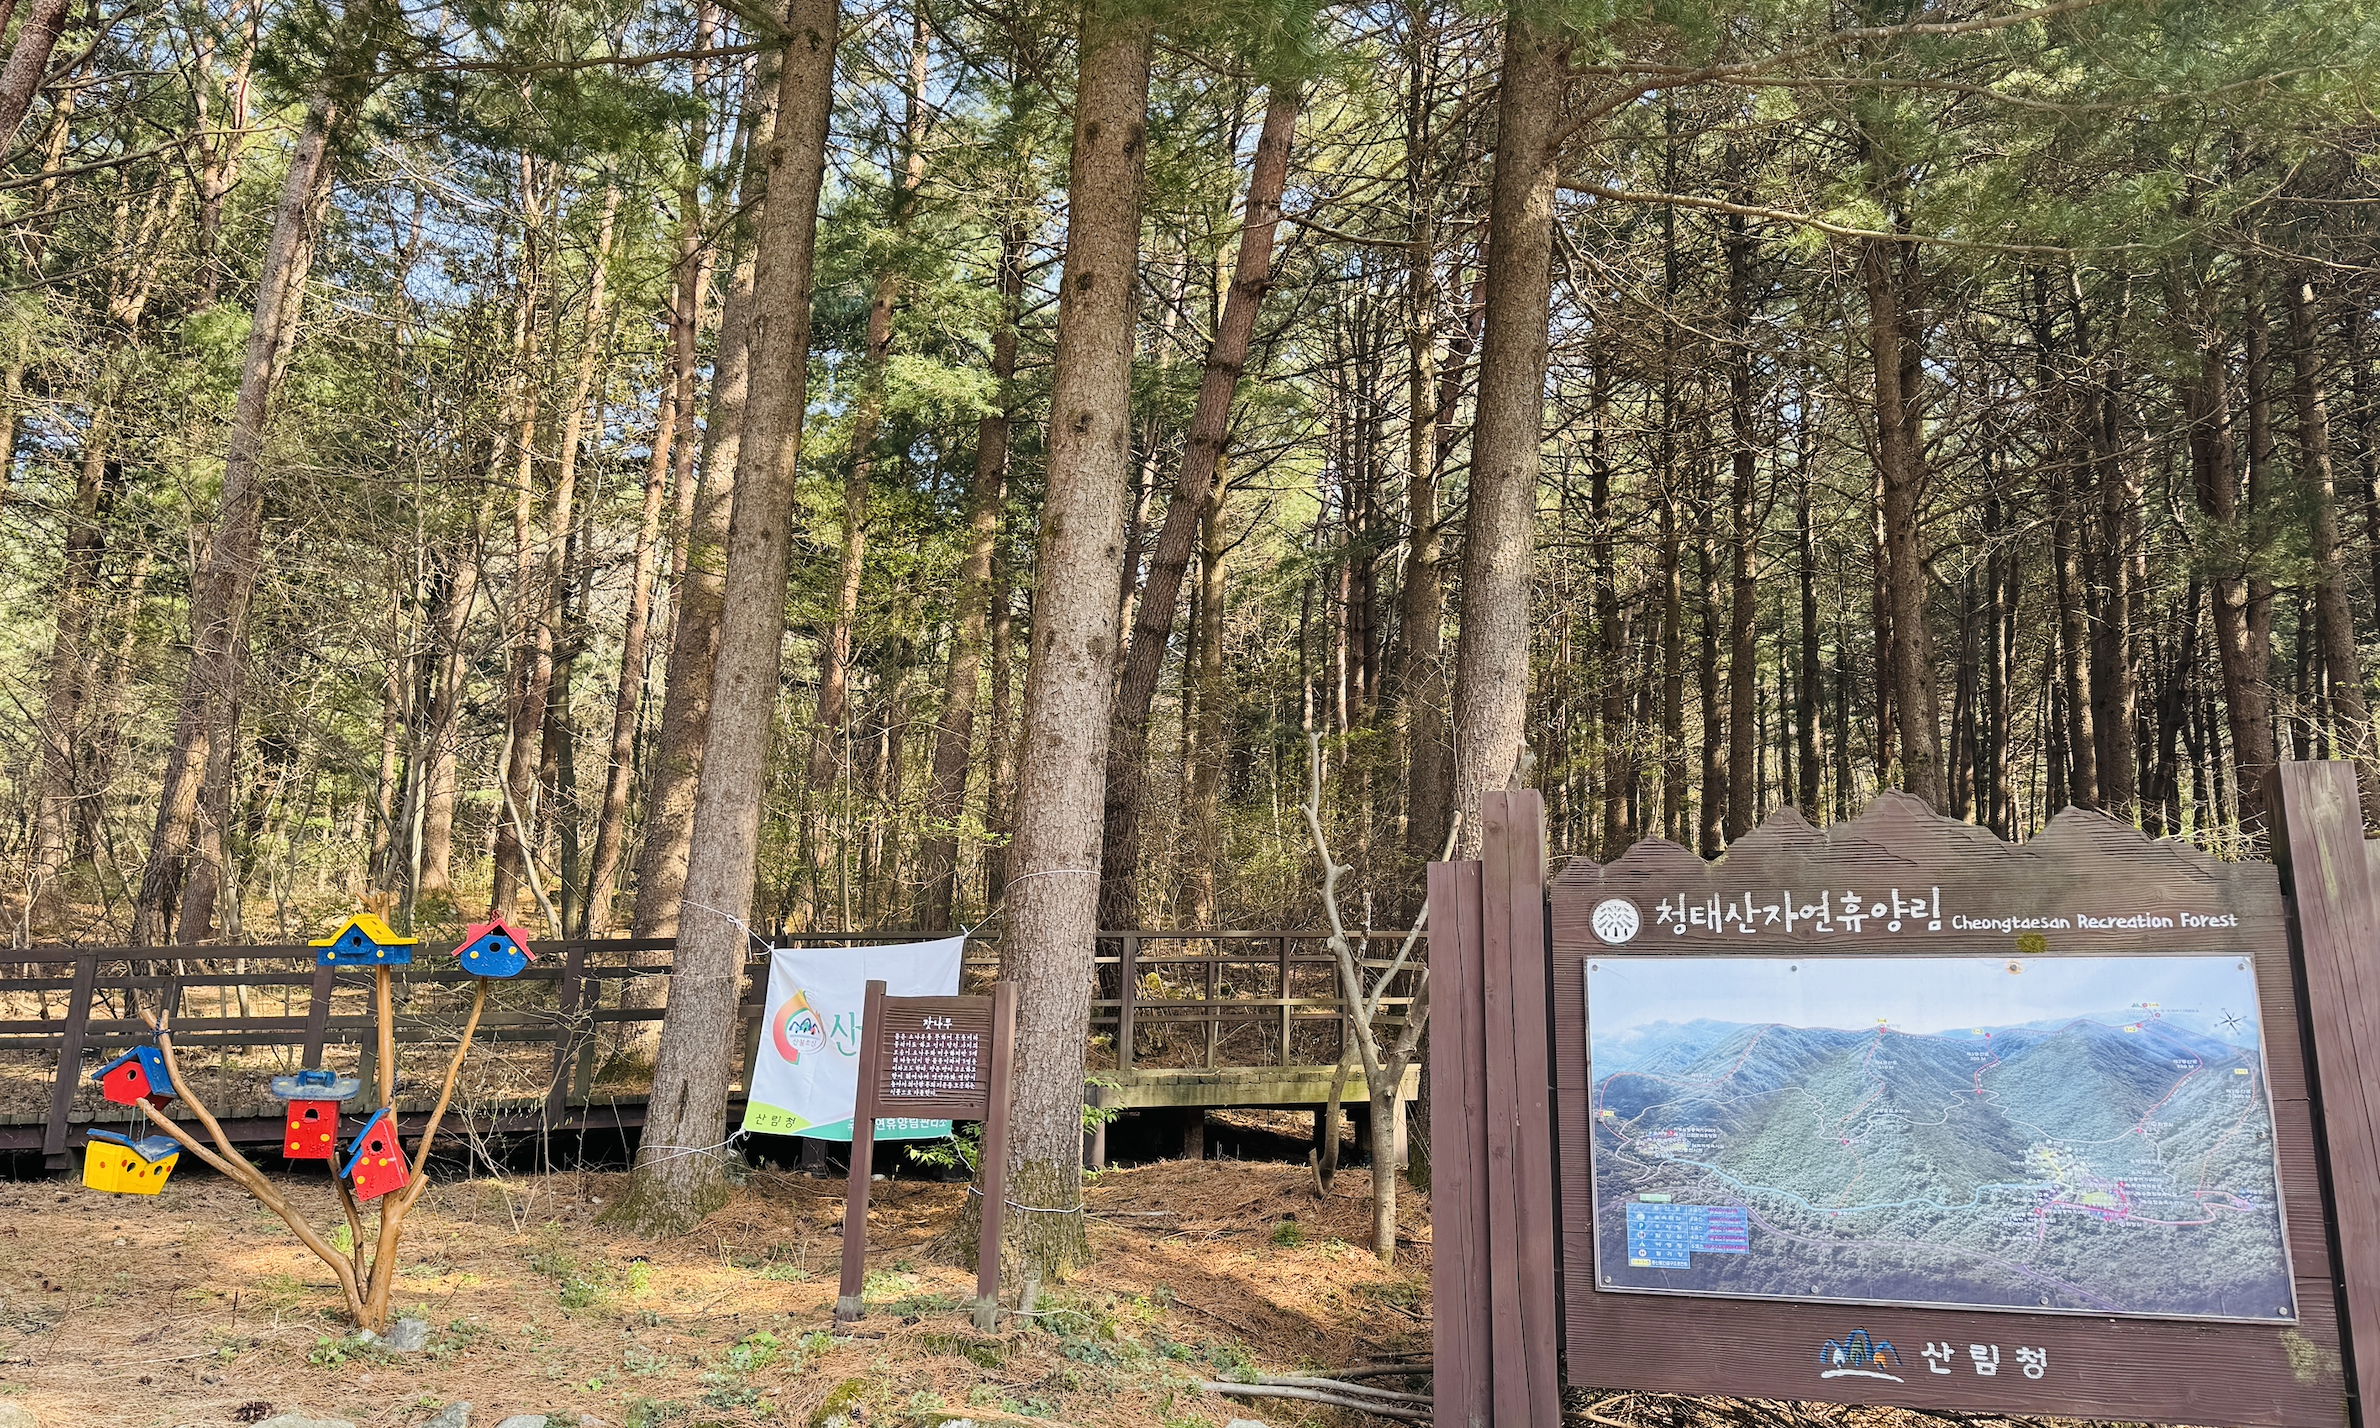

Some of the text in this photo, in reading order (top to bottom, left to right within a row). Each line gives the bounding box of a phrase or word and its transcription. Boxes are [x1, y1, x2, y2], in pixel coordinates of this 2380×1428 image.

[1656, 886, 1942, 934] 청태산자연휴양림
[1951, 911, 2239, 933] Cheongtaesan Recreation Forest
[922, 1015, 953, 1030] 잣나무
